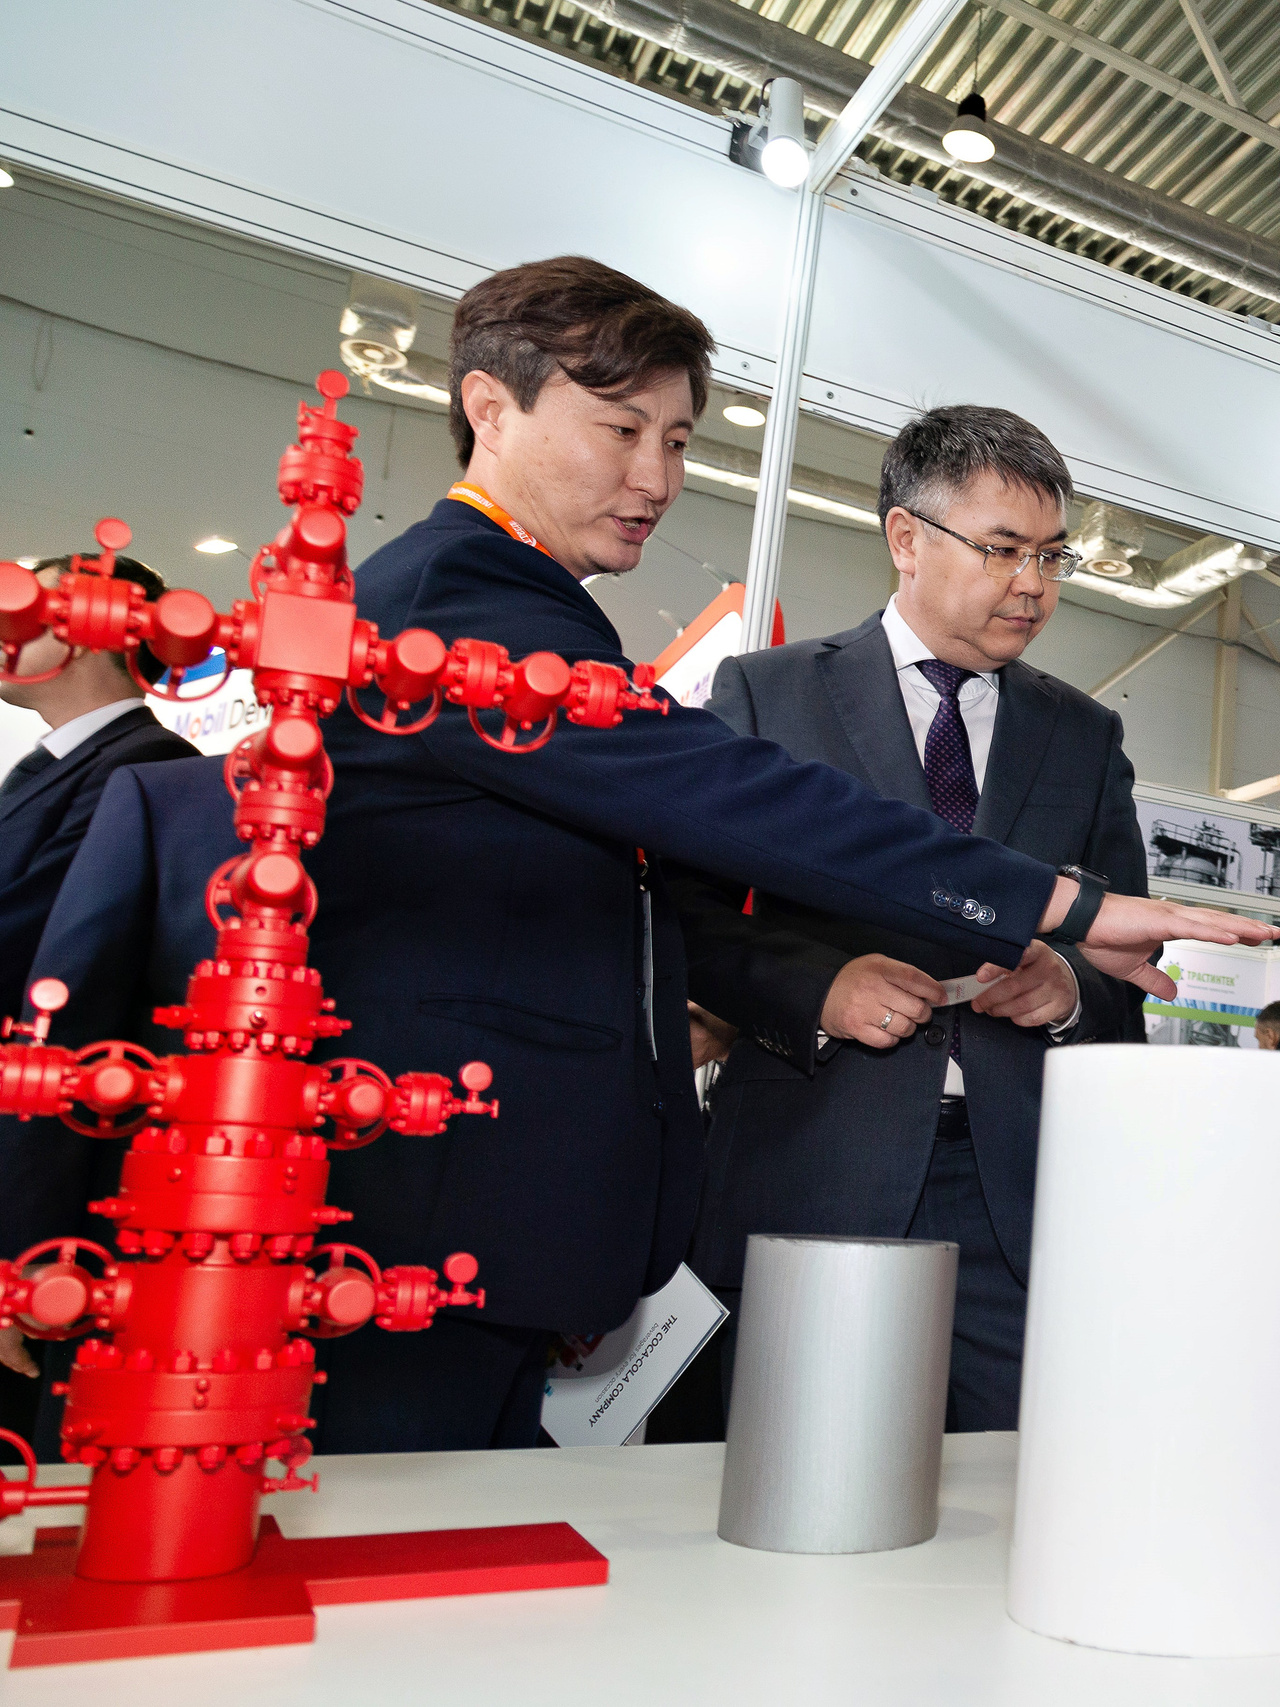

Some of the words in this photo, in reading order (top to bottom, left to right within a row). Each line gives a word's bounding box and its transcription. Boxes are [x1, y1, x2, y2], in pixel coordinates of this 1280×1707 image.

[174, 701, 227, 739] Mobil
[1186, 970, 1236, 987] ТРАСТИНТЕК
[635, 1322, 659, 1353] beverages
[661, 1314, 678, 1334] THE
[615, 1361, 629, 1378] every
[622, 1332, 663, 1383] COCA-COLA
[594, 1377, 616, 1403] occasion
[588, 1382, 624, 1428] COMPANY
